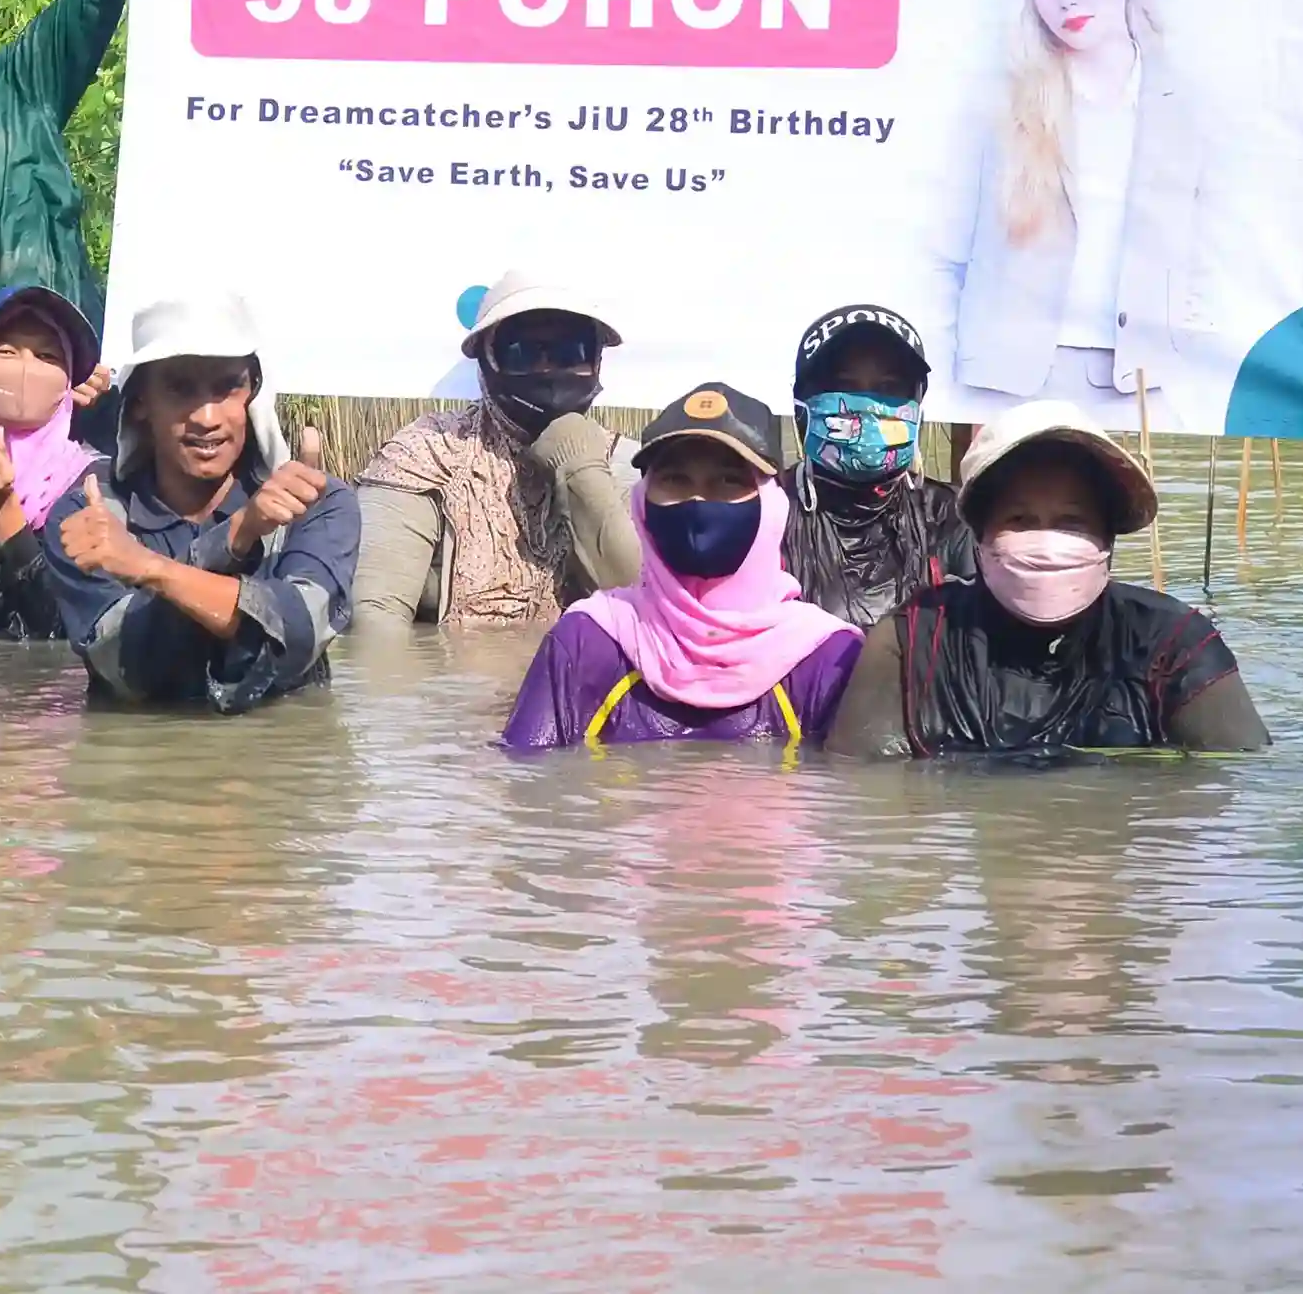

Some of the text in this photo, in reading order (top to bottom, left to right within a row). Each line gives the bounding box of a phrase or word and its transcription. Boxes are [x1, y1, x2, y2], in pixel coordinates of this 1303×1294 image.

[186, 96, 895, 144] For Dreamcatcher’s JiU 28th Birthday
[339, 159, 725, 193] “Save Earth, Save Us”
[803, 309, 923, 360] SPORT
